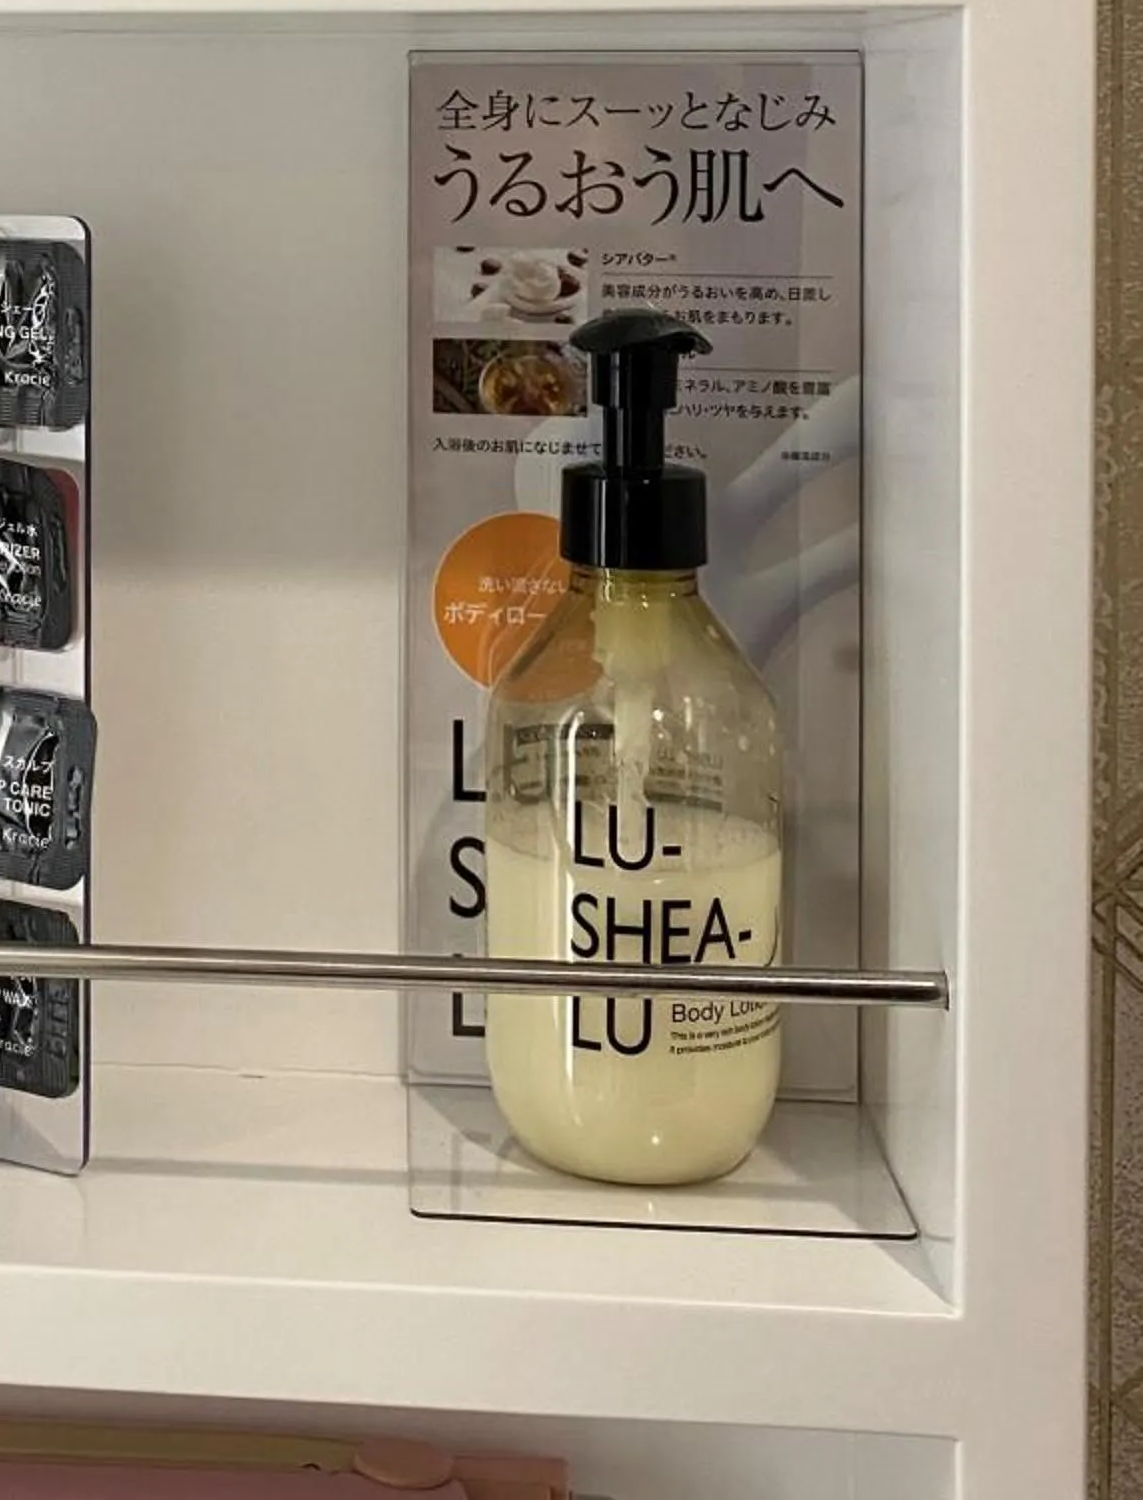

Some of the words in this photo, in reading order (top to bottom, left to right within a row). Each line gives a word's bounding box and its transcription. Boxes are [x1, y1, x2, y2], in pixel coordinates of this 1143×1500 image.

[436, 88, 836, 133] 全身にスーッとなじみ
[433, 144, 845, 227] うるおう肌へ
[18, 325, 49, 341] GEL
[4, 371, 52, 387] Kracie
[3, 797, 52, 818] TONIC
[10, 781, 53, 800] CARE
[573, 800, 682, 871] LU-
[569, 892, 753, 966] SHEA-
[572, 996, 653, 1056] LU
[672, 1000, 725, 1026] Body
